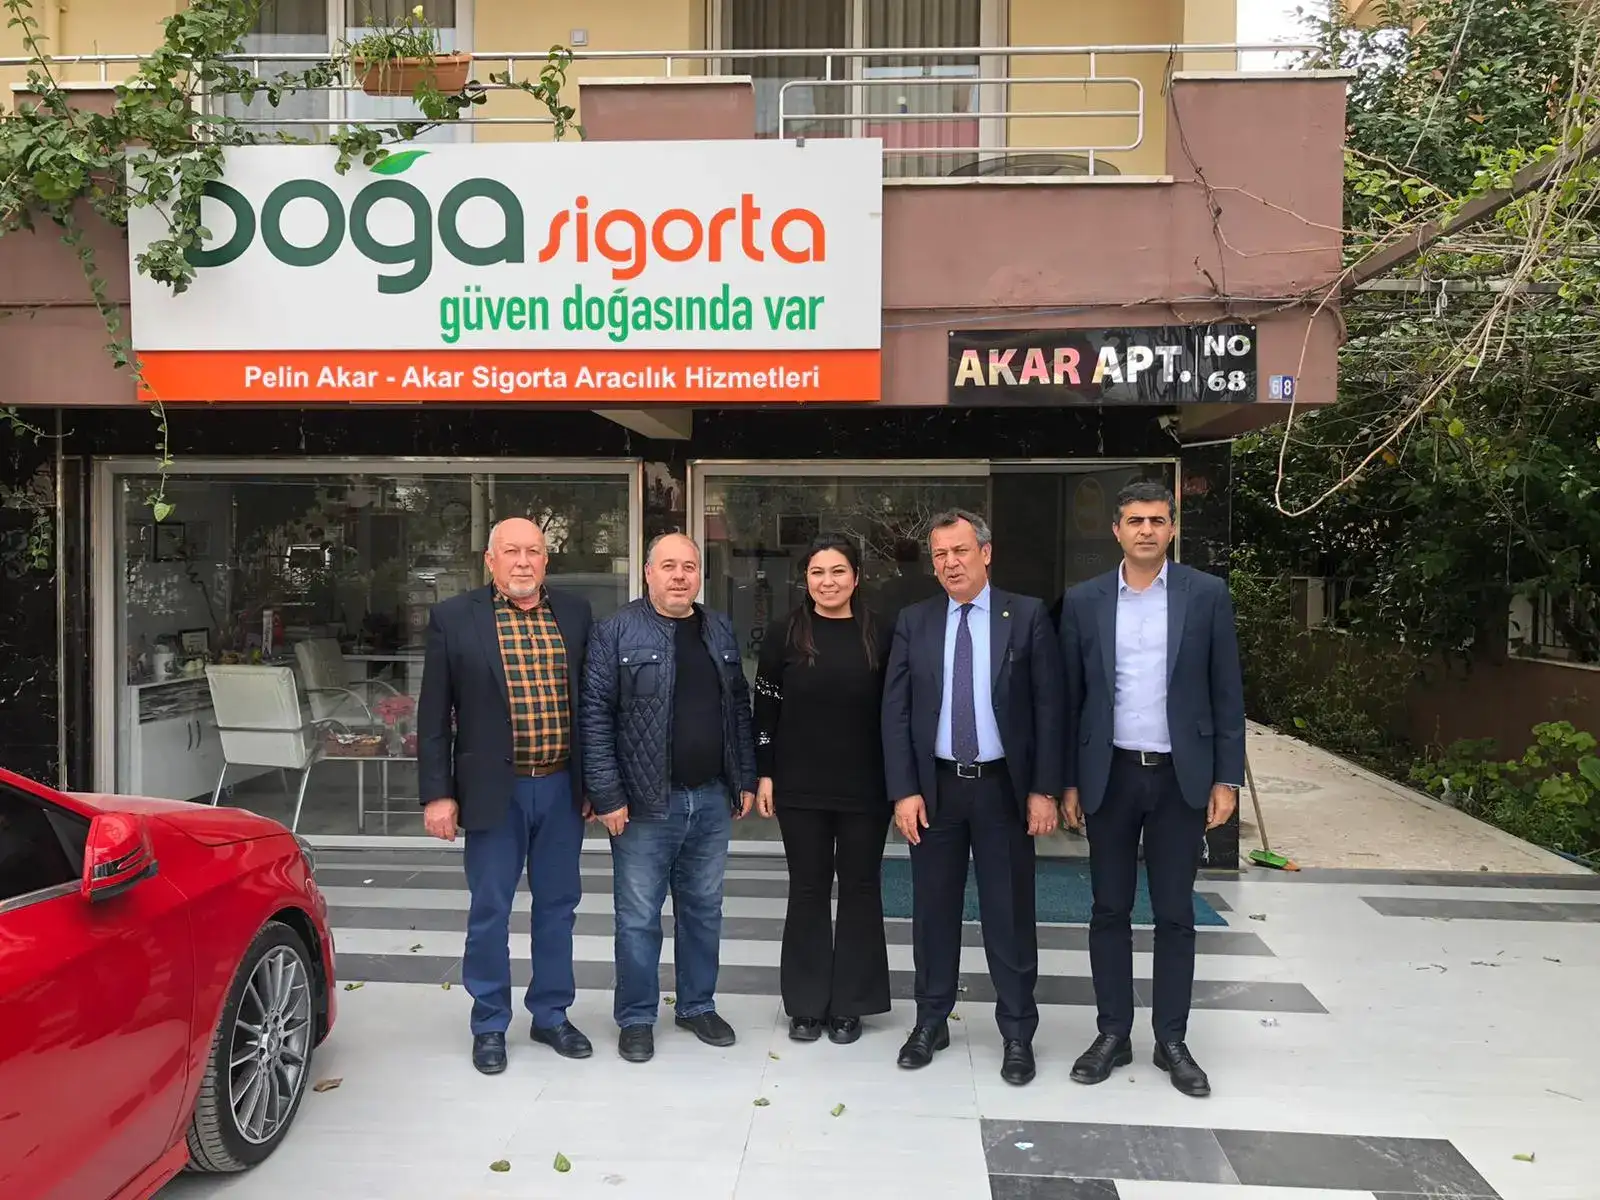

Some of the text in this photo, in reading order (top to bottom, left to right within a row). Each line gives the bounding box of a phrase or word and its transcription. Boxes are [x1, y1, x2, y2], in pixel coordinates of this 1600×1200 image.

[538, 193, 826, 281] sigorta
[439, 283, 825, 344] güven doğasında var
[1204, 334, 1251, 357] NO
[245, 365, 309, 388] Pelin
[316, 365, 379, 388] Akar
[401, 365, 465, 388] Akar
[472, 365, 568, 394] Sigorta
[574, 366, 677, 389] Aracılık
[685, 365, 820, 389] Hizmetleri
[954, 345, 1192, 387] AKAR APT.
[1207, 370, 1247, 392] 68
